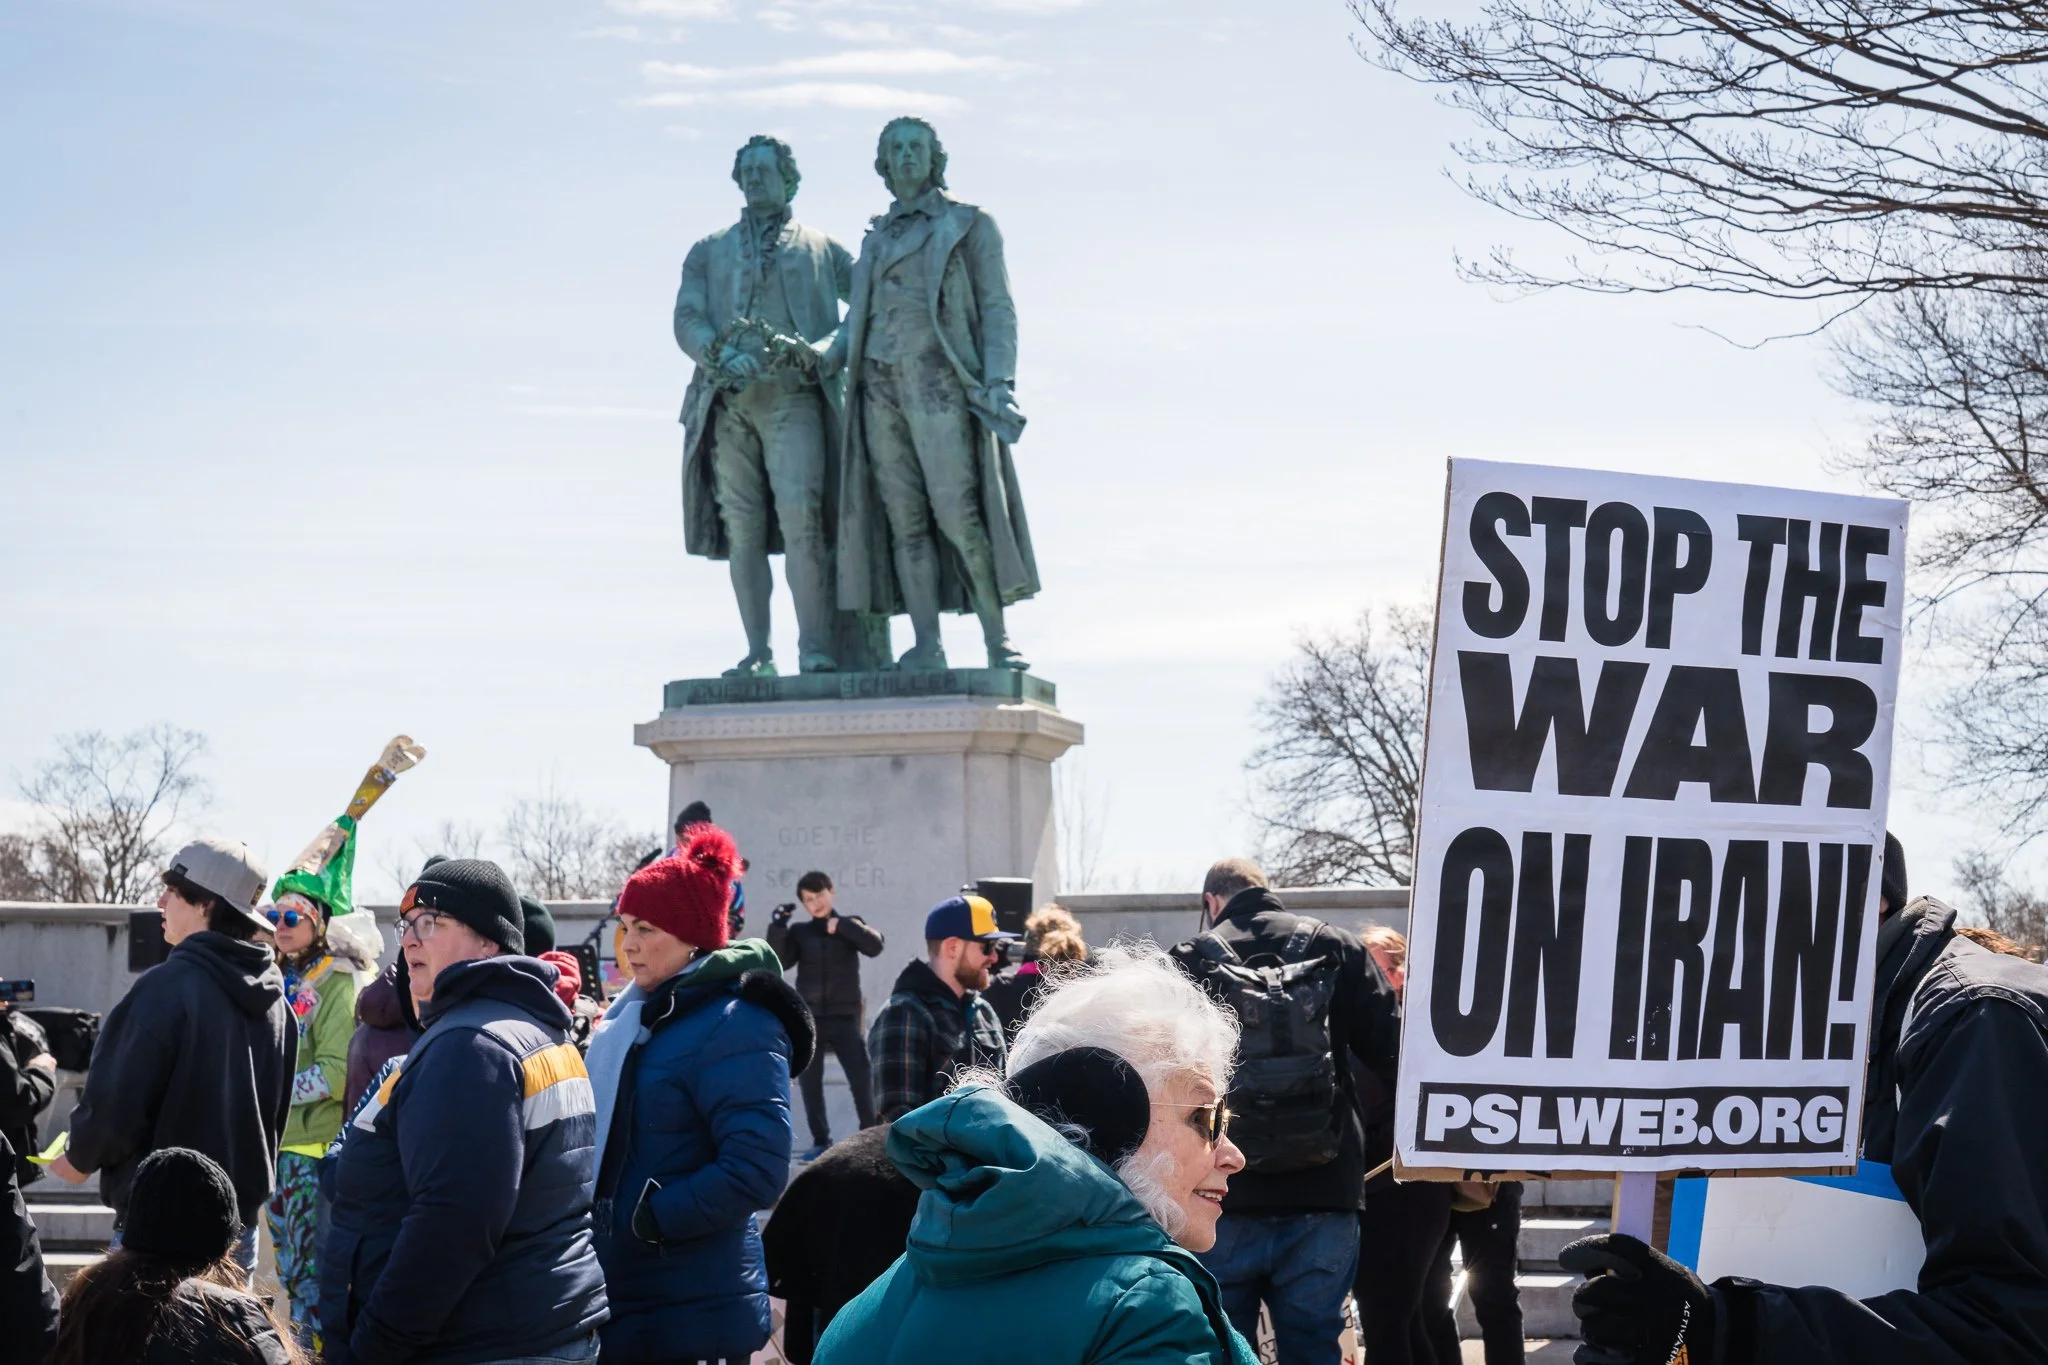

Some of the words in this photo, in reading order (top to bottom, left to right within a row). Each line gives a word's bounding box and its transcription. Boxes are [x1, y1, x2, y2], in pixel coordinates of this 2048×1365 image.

[1462, 491, 1713, 650] STOP
[1737, 513, 1890, 664] THE
[1457, 649, 1878, 810] WAR
[764, 866, 887, 889] SCLER
[778, 825, 876, 847] GOETHE
[1430, 826, 1592, 1059] ON
[1608, 835, 1873, 1061] IRAN!
[1423, 1092, 1844, 1147] PSLWEB.ORG
